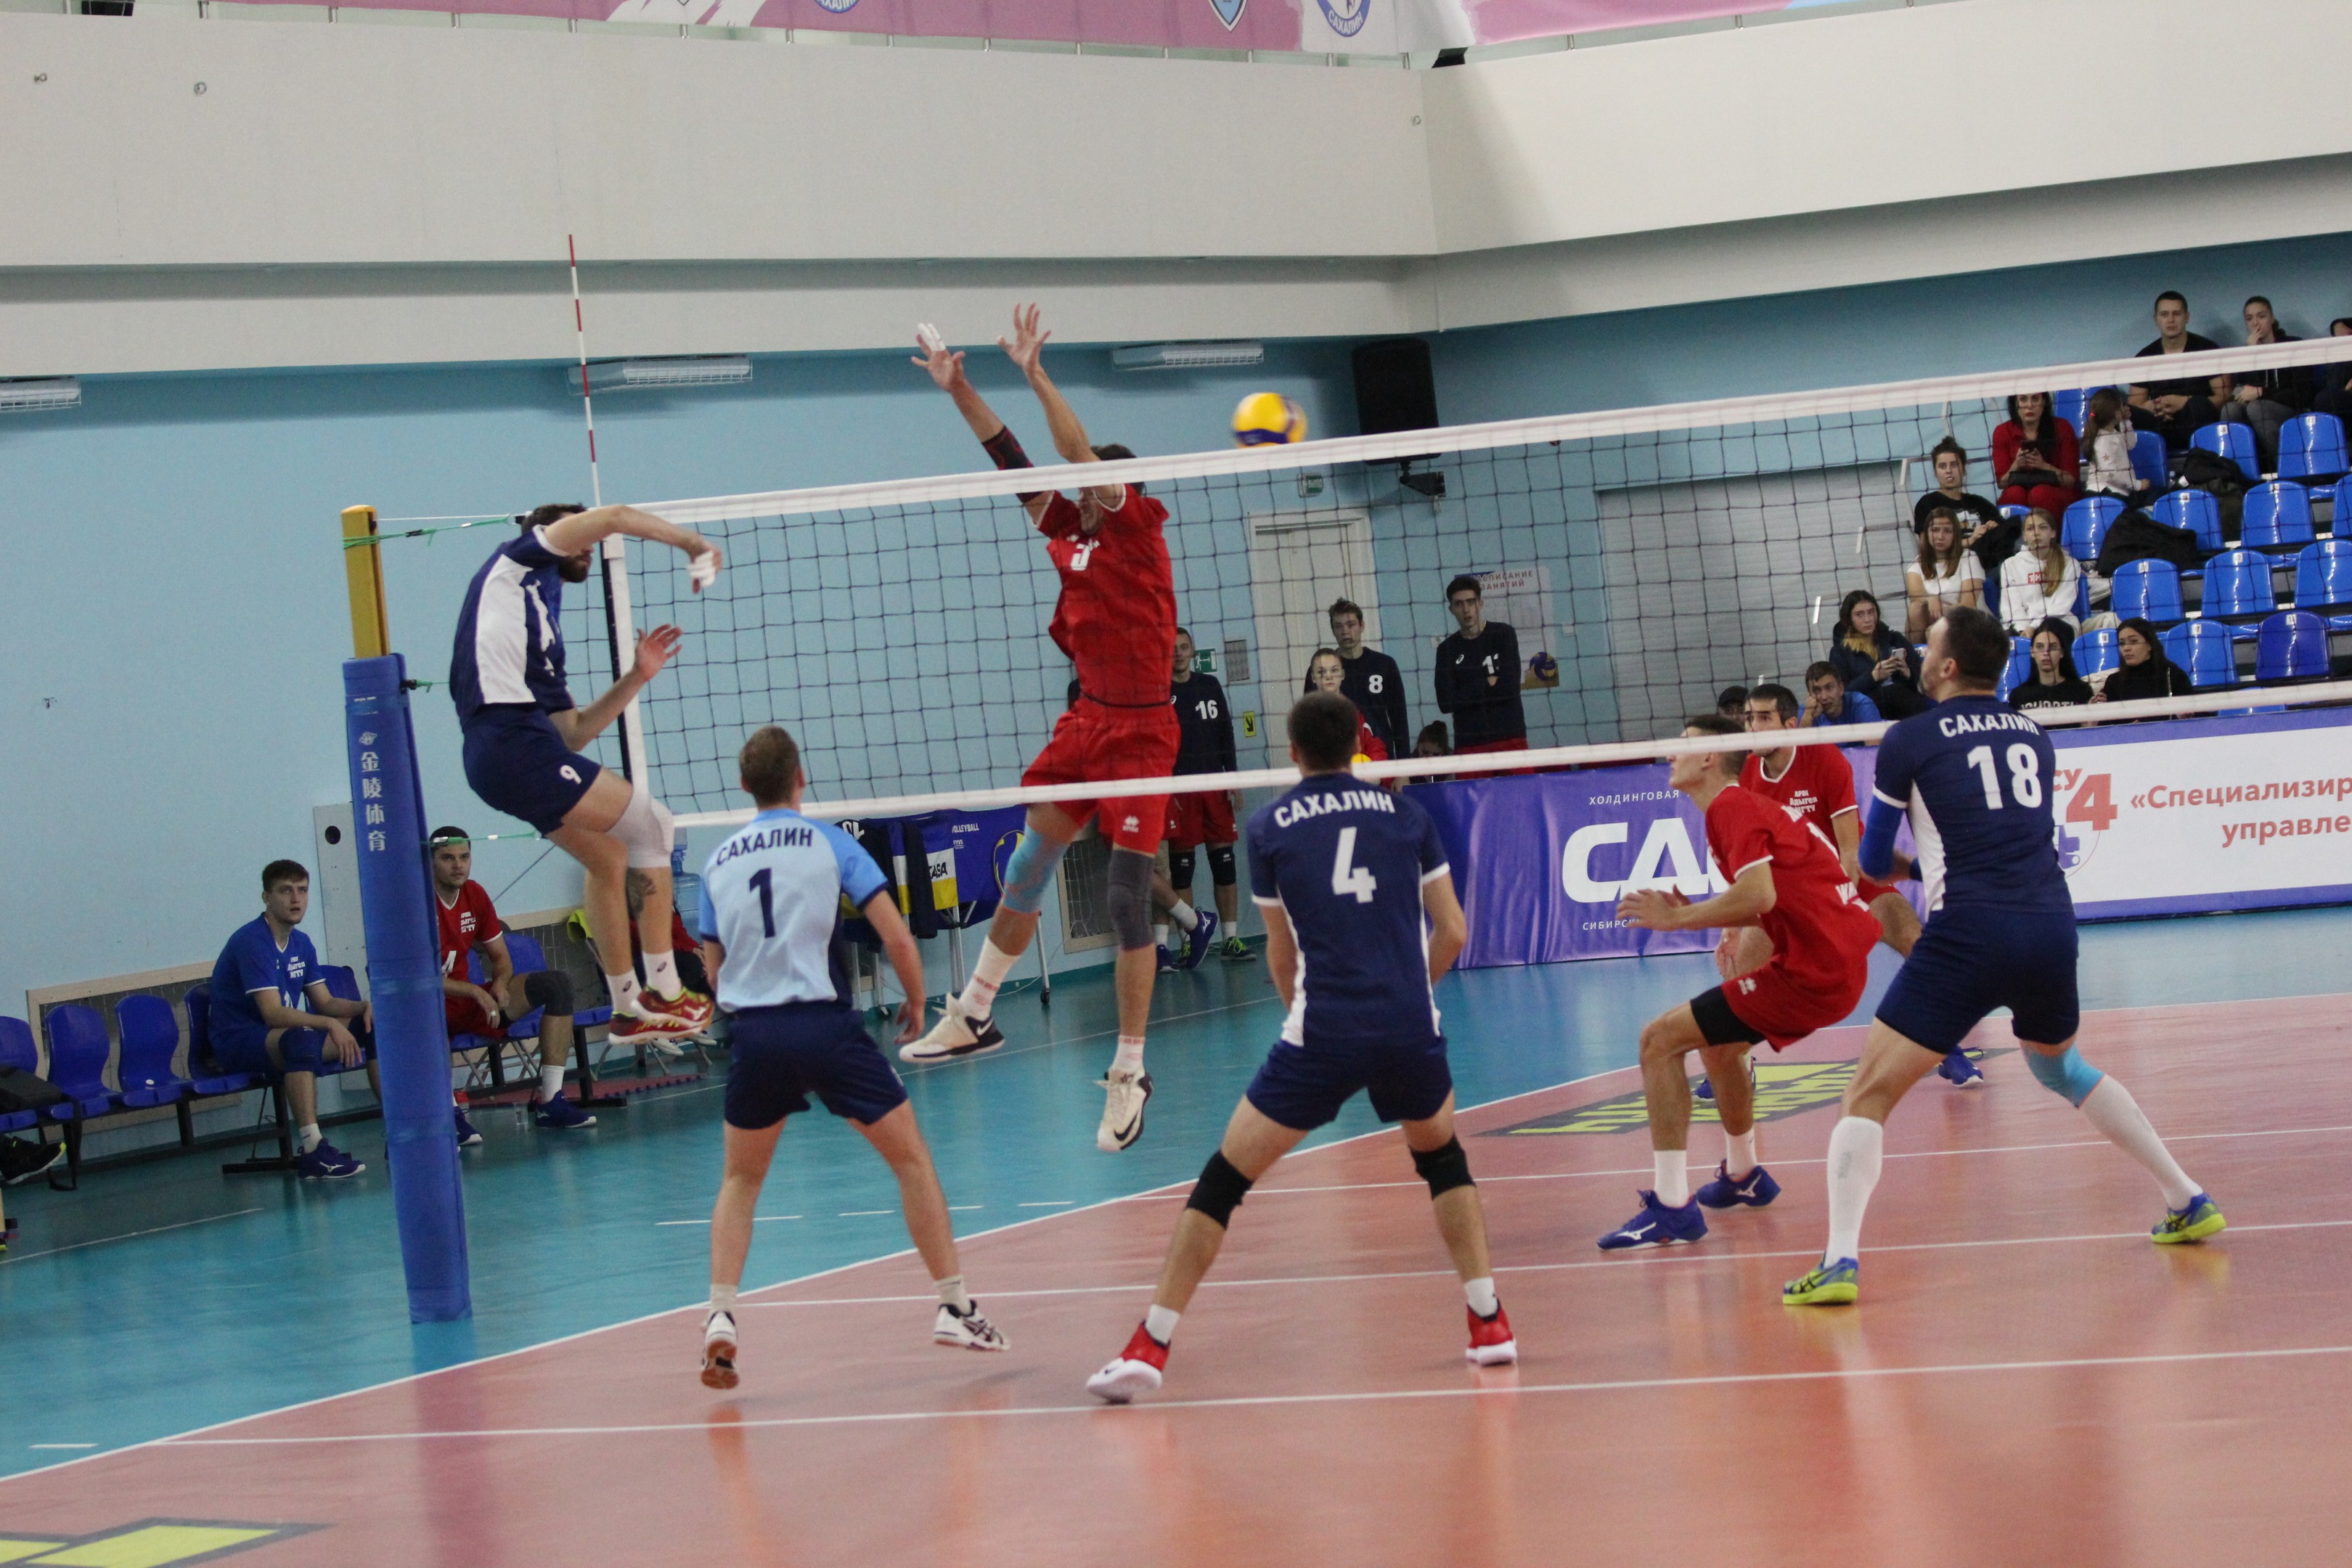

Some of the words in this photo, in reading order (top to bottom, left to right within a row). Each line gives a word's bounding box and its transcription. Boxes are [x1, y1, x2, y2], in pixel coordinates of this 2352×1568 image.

[1328, 10, 1363, 34] САХАЛИН
[1481, 579, 1525, 591] ЗАНЯТИЙ
[1368, 674, 1383, 693] 8
[1195, 699, 1218, 719] 16
[1939, 714, 2040, 738] САХАЛИН
[560, 764, 582, 784] 9
[1967, 743, 2042, 810] 18
[360, 751, 386, 852] 金陵体育
[1274, 790, 1396, 828] САХАЛИН
[1590, 789, 1680, 806] ХОЛДИНГОВАЯ
[2131, 776, 2352, 809] «Специализир
[716, 827, 813, 865] САХАЛИН
[2221, 814, 2352, 849] управле
[1331, 826, 1377, 904] 4
[749, 867, 775, 939] 1
